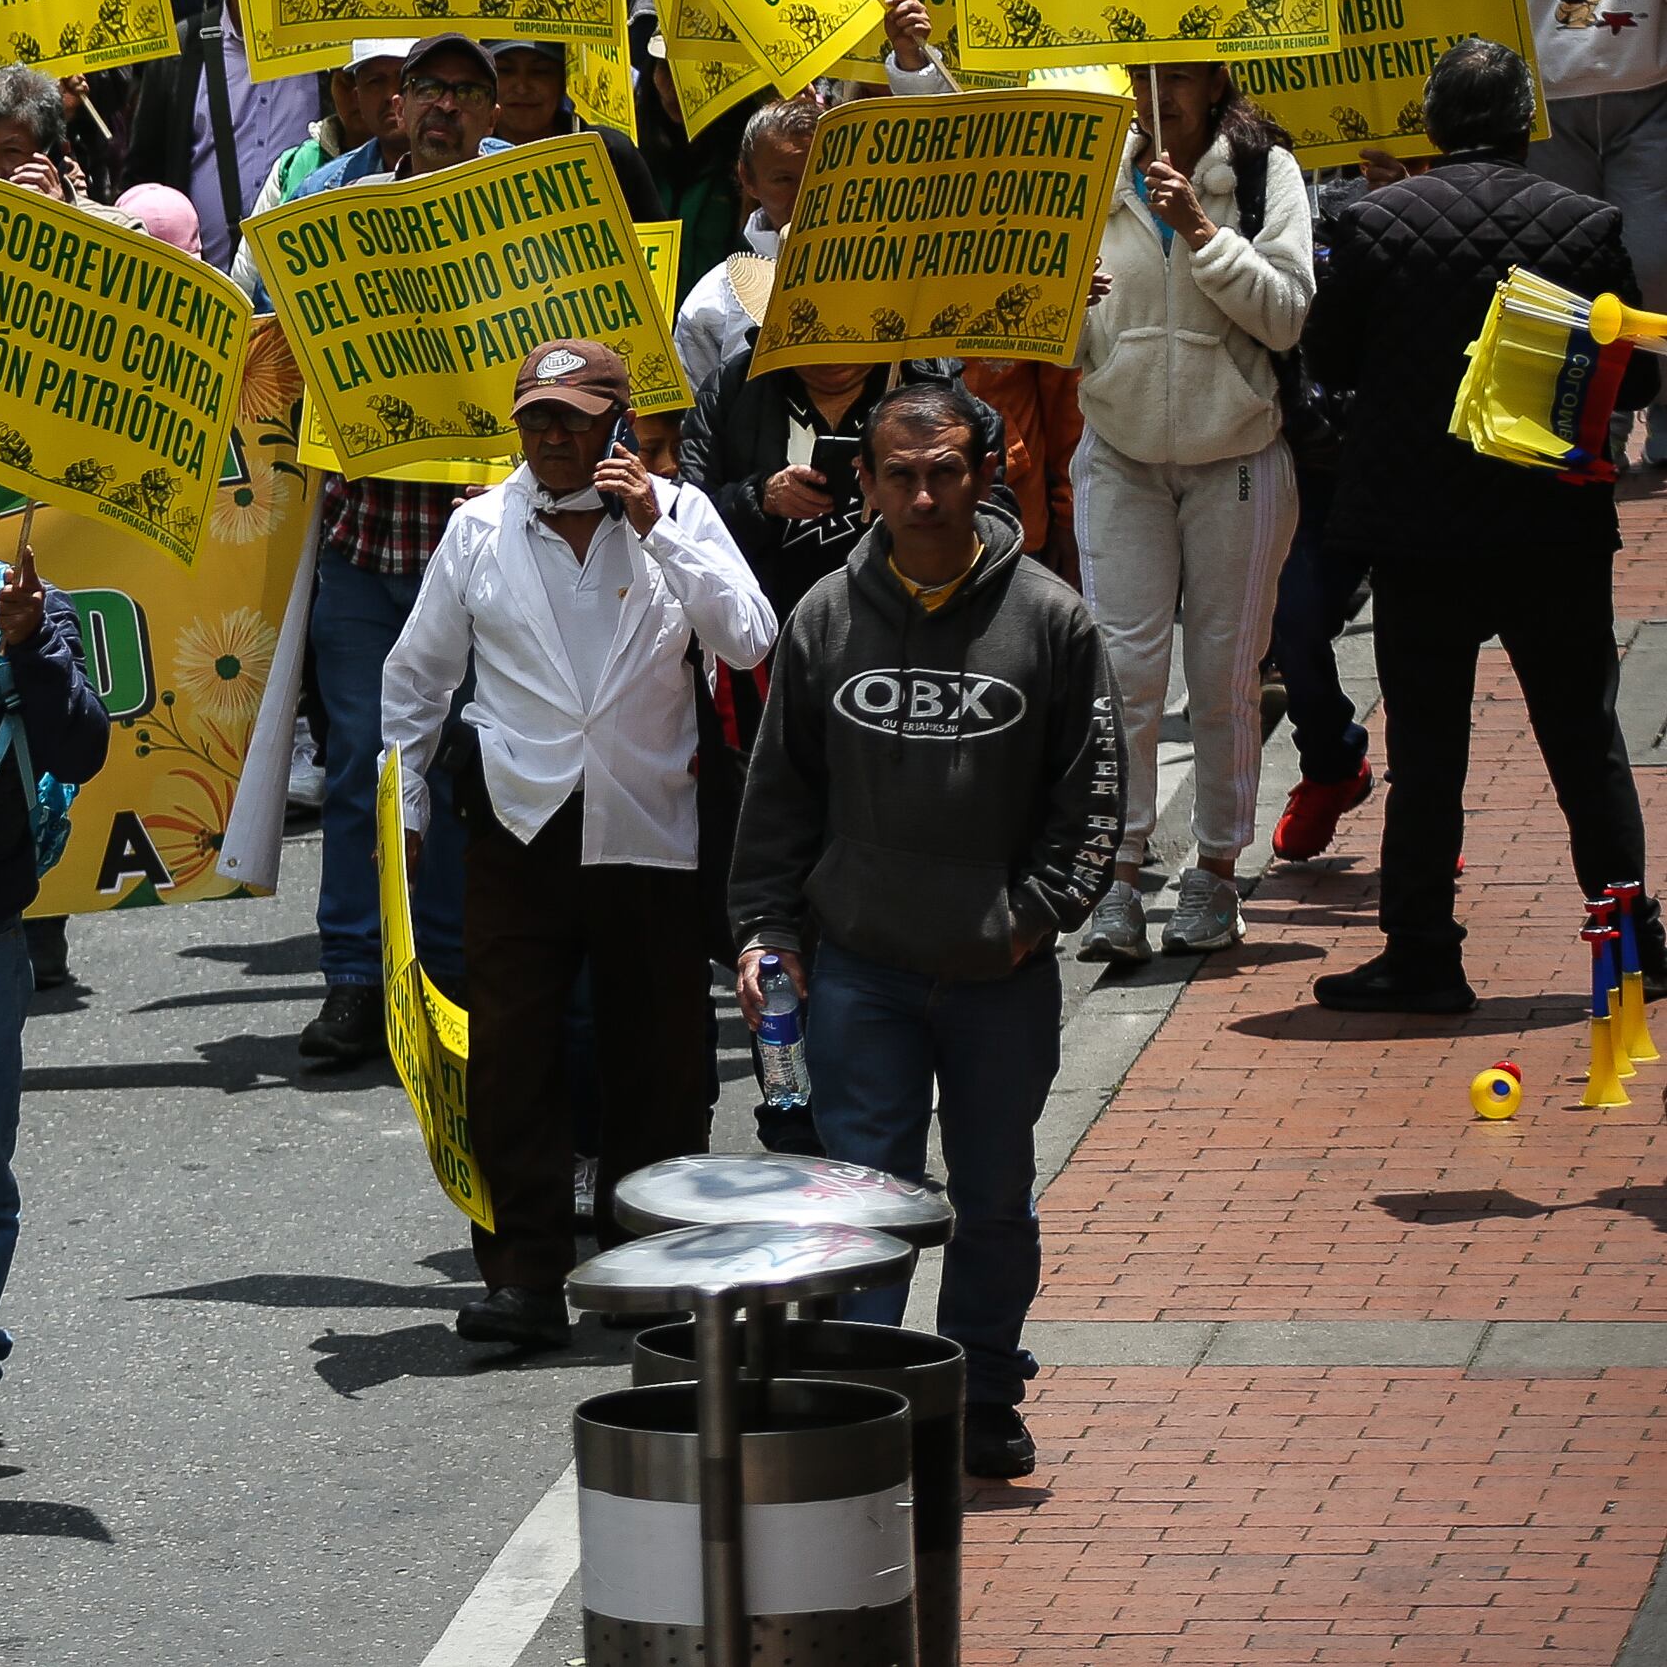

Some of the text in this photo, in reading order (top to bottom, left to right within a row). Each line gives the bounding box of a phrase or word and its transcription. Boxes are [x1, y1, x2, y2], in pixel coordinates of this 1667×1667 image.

[574, 25, 613, 38] REINICIAR
[1216, 35, 1330, 53] CORPORACIÓN REINICIAR
[815, 110, 1104, 175] SOY SOBREVIVIENTE
[796, 169, 1089, 234] DEL GENOCIDIO CONTRA
[782, 217, 1069, 292] LA UNIÓN PATRIÓTICA
[122, 324, 226, 424] CONTRA
[1016, 340, 1064, 356] REINICIAR
[34, 358, 208, 483] PATRIÓTICA
[98, 501, 193, 568] CORPORACIÓN REINICIAR
[854, 675, 994, 720] OBX
